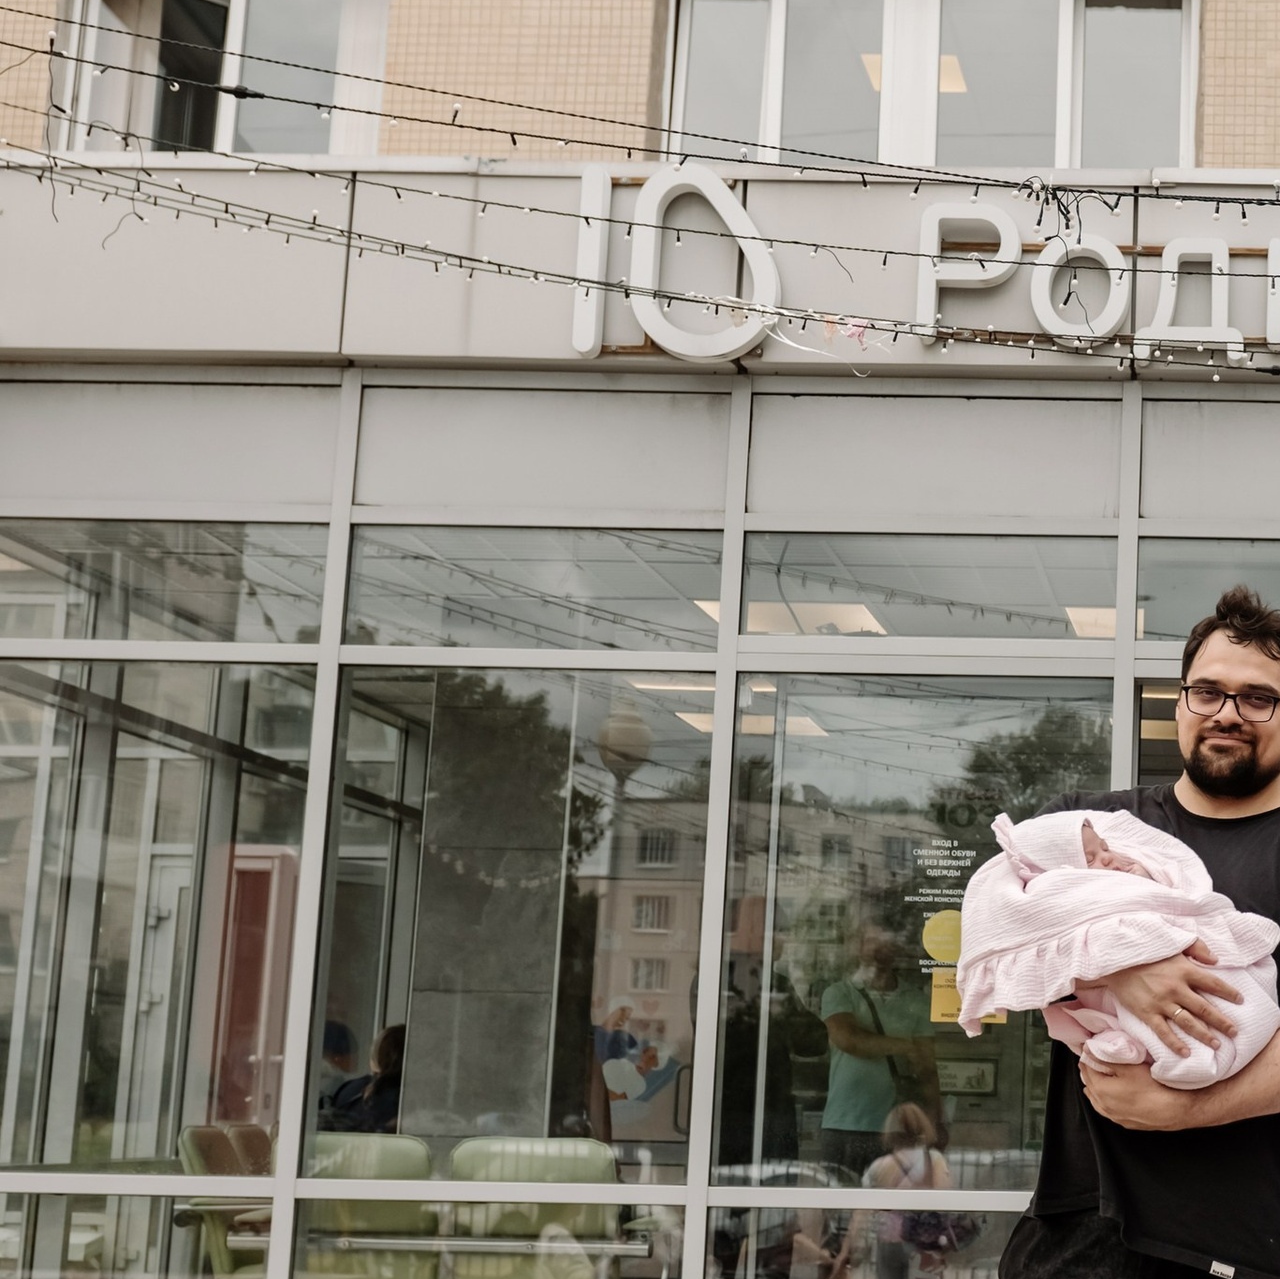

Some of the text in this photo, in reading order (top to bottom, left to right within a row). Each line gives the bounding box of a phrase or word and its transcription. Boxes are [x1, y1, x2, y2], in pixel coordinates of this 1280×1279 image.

[932, 839, 952, 847] ВХОД
[951, 849, 977, 857] ОБУВИ
[924, 858, 938, 866] БЕЗ
[939, 858, 971, 867] ВЕРХНЕЙ
[926, 868, 961, 877] ОДЕЖДЫ
